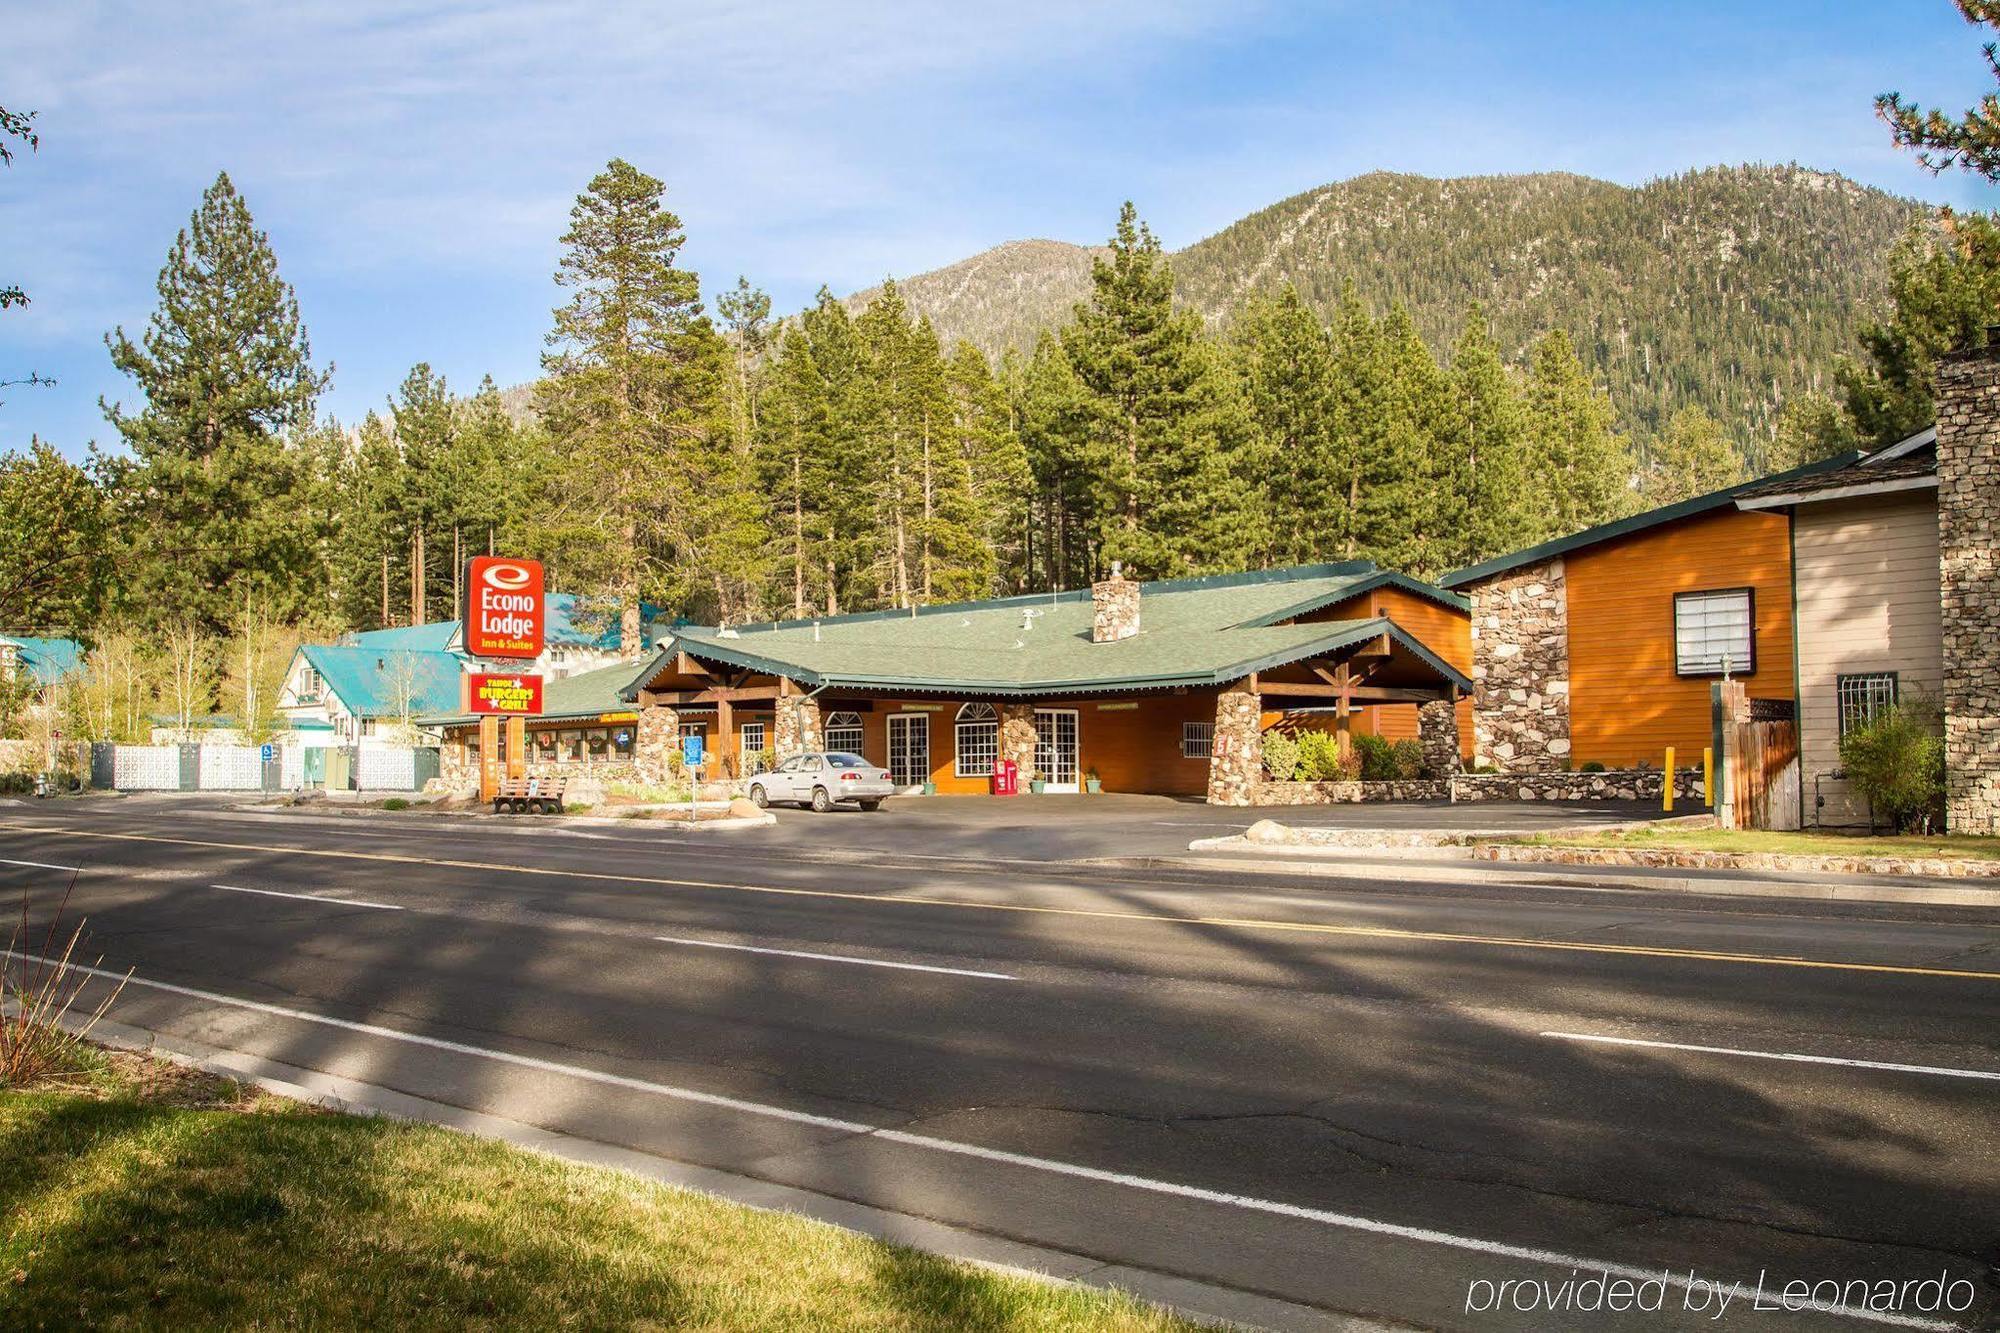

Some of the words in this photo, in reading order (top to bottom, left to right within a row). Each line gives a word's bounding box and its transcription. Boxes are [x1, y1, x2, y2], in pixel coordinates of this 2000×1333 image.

[482, 587, 534, 612] Econo
[482, 610, 534, 639] Lodge
[482, 638, 497, 648] Inn
[498, 639, 505, 649] &
[506, 640, 533, 650] Suites
[479, 687, 534, 700] BURGERS
